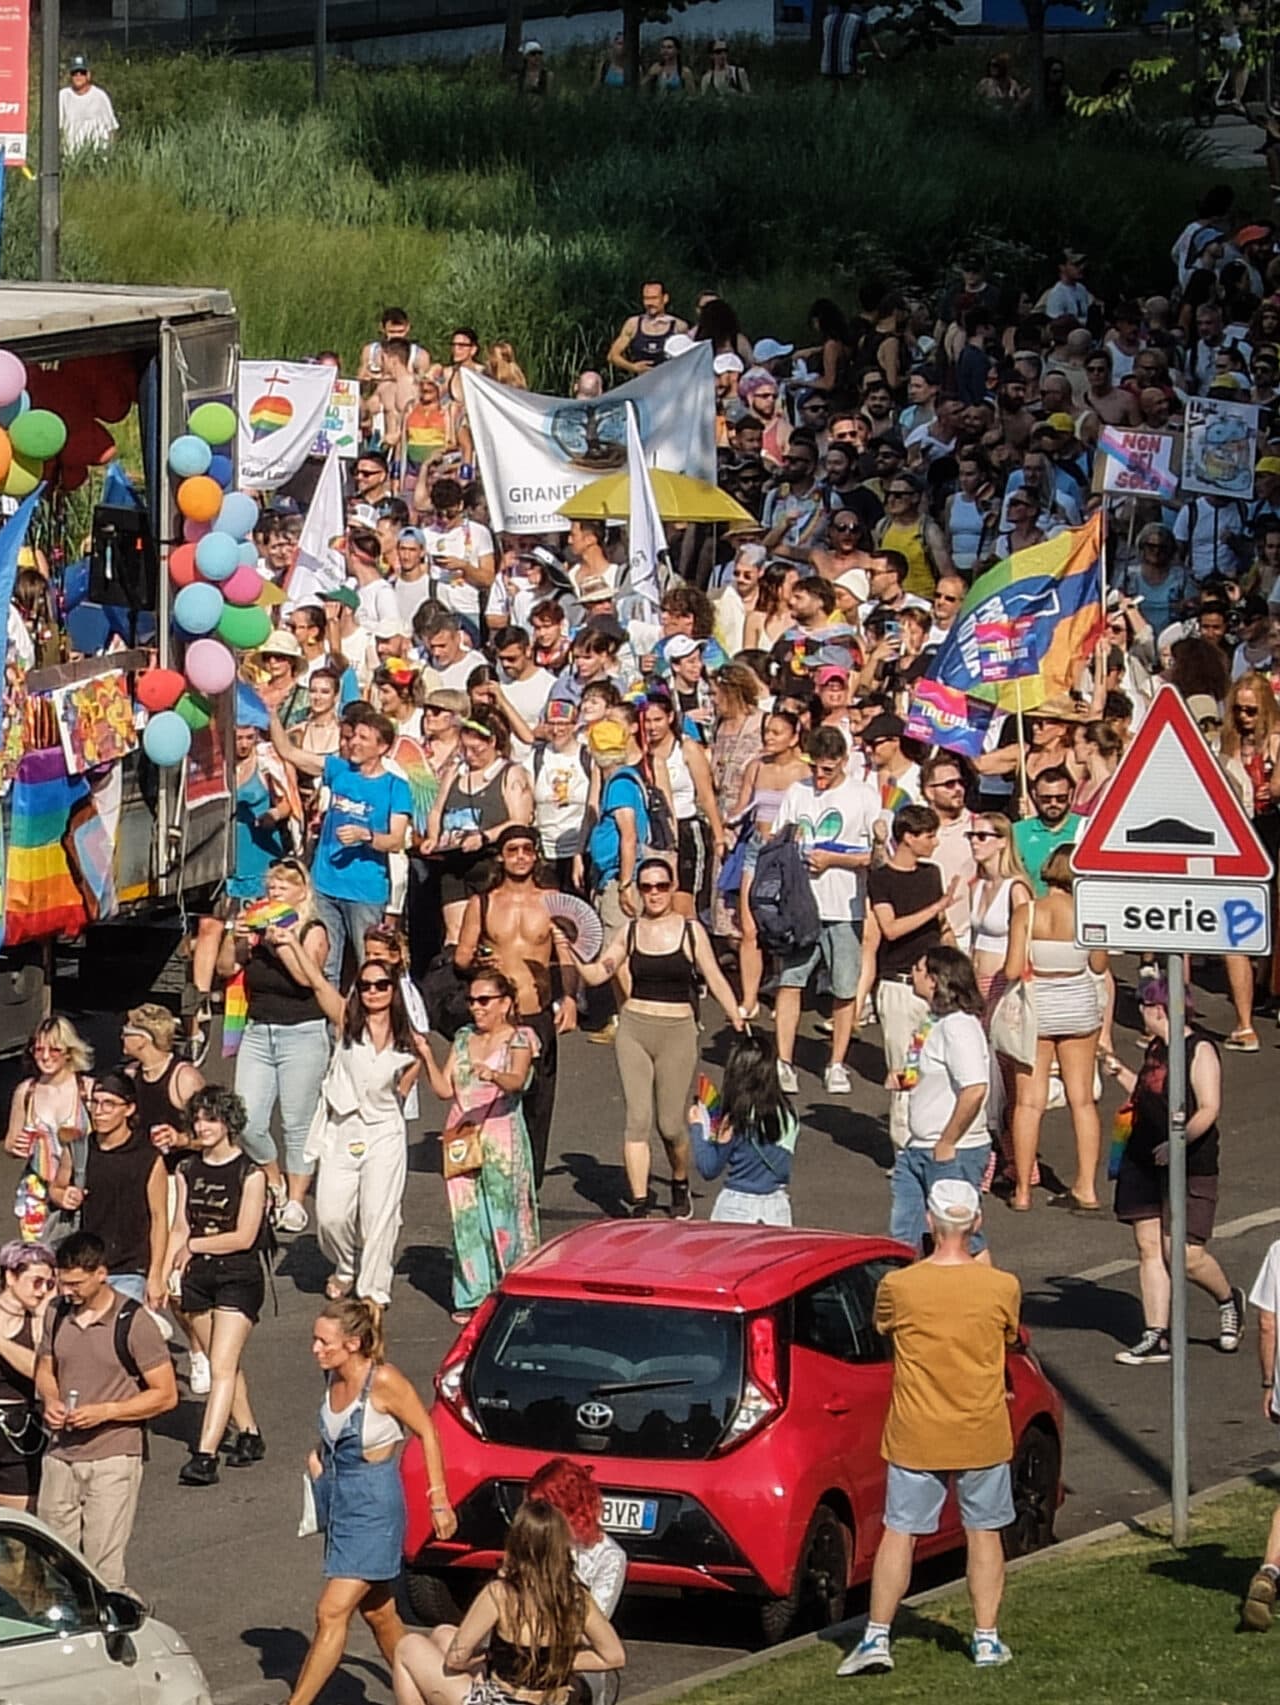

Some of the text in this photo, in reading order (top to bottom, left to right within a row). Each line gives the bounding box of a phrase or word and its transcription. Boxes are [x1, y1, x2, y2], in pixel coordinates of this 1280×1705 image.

[1122, 434, 1161, 453] NON
[1123, 899, 1218, 932] serie
[1224, 899, 1264, 947] B
